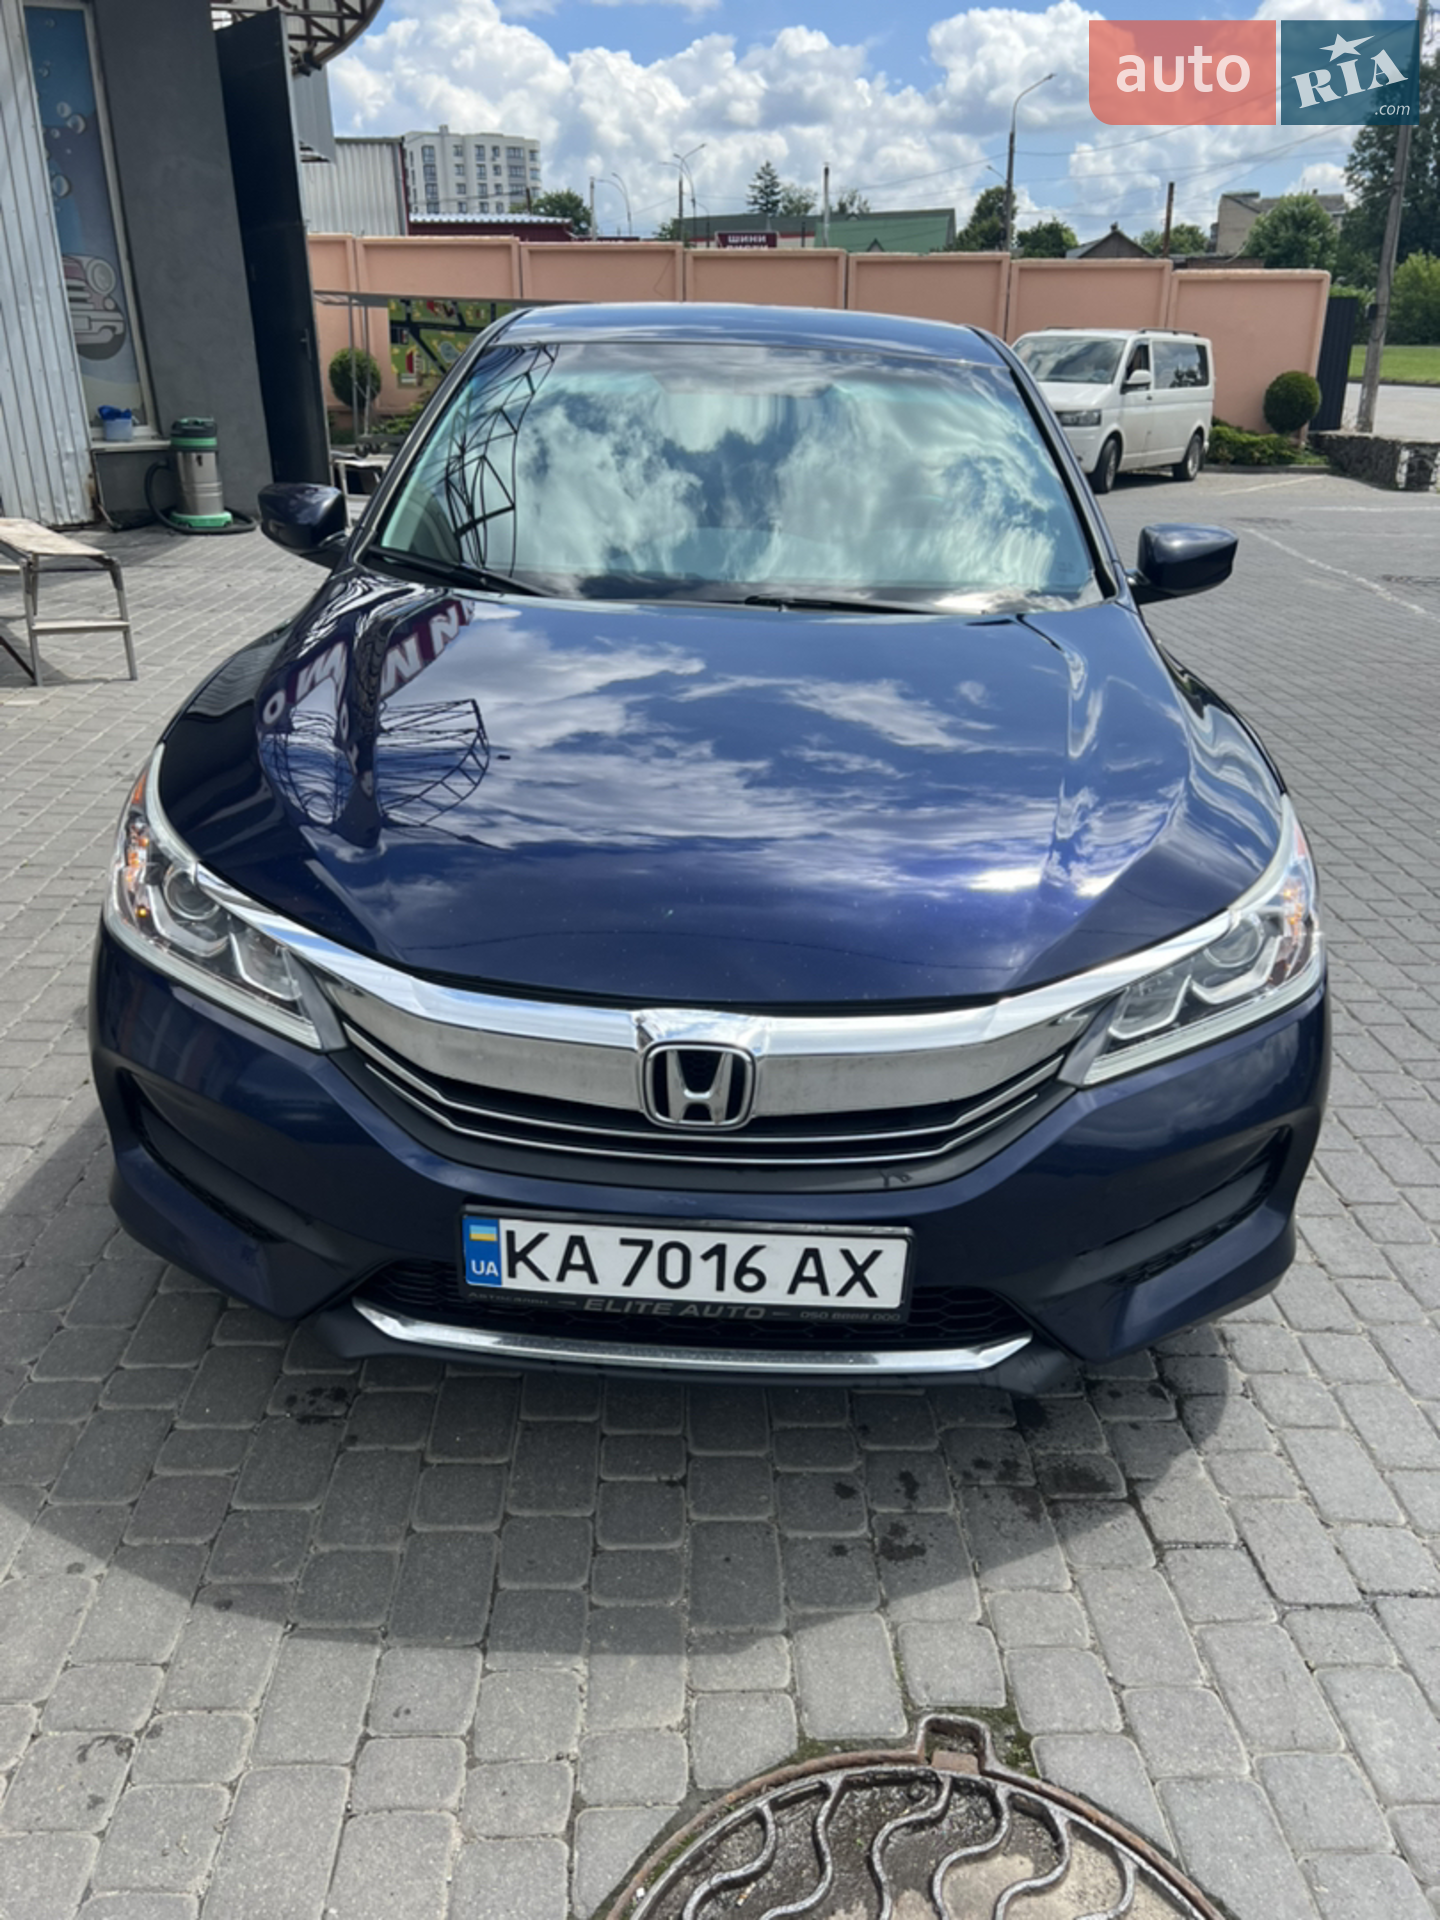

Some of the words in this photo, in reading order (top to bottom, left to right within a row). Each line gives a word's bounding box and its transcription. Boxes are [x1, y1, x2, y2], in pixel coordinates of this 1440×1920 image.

[470, 1258, 499, 1277] UA
[505, 1229, 599, 1285] KA
[618, 1237, 767, 1293] 7016
[786, 1246, 884, 1299] AX
[583, 1297, 675, 1316] ELITE
[677, 1304, 767, 1320] AUTO
